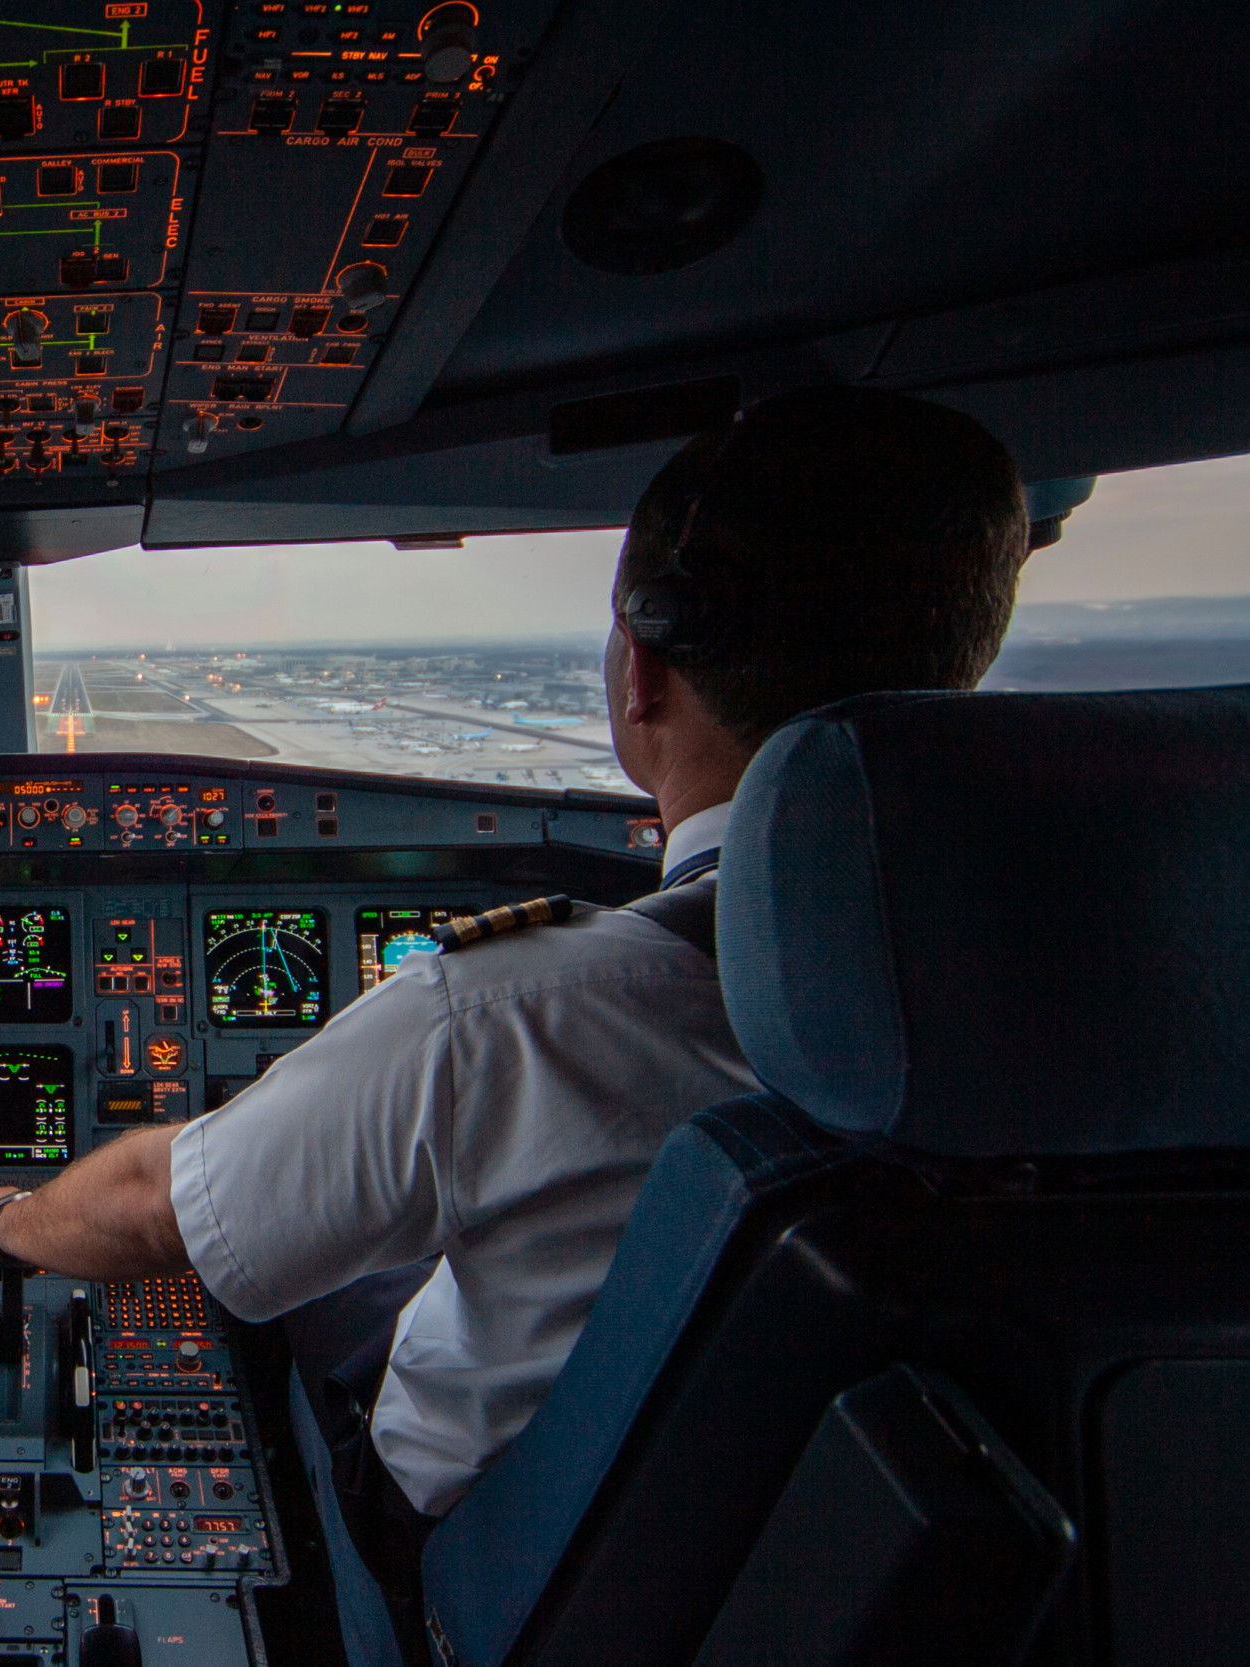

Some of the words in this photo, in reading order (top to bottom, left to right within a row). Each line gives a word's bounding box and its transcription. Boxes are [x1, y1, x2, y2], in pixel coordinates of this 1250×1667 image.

[135, 6, 141, 14] 2
[341, 52, 365, 60] STBY
[369, 52, 388, 60] NAV
[484, 56, 498, 64] ON
[187, 29, 210, 100] FUEL
[286, 136, 330, 146] CARGO
[337, 136, 358, 146] AIR
[367, 136, 403, 146] COND
[90, 156, 145, 165] COMMERCIAL
[166, 198, 185, 248] ELEC
[252, 296, 287, 304] CARGO
[294, 296, 330, 304] SMOKE
[152, 323, 166, 350] AIR
[201, 792, 225, 801] 1027
[158, 1636, 184, 1644] FLAPS
